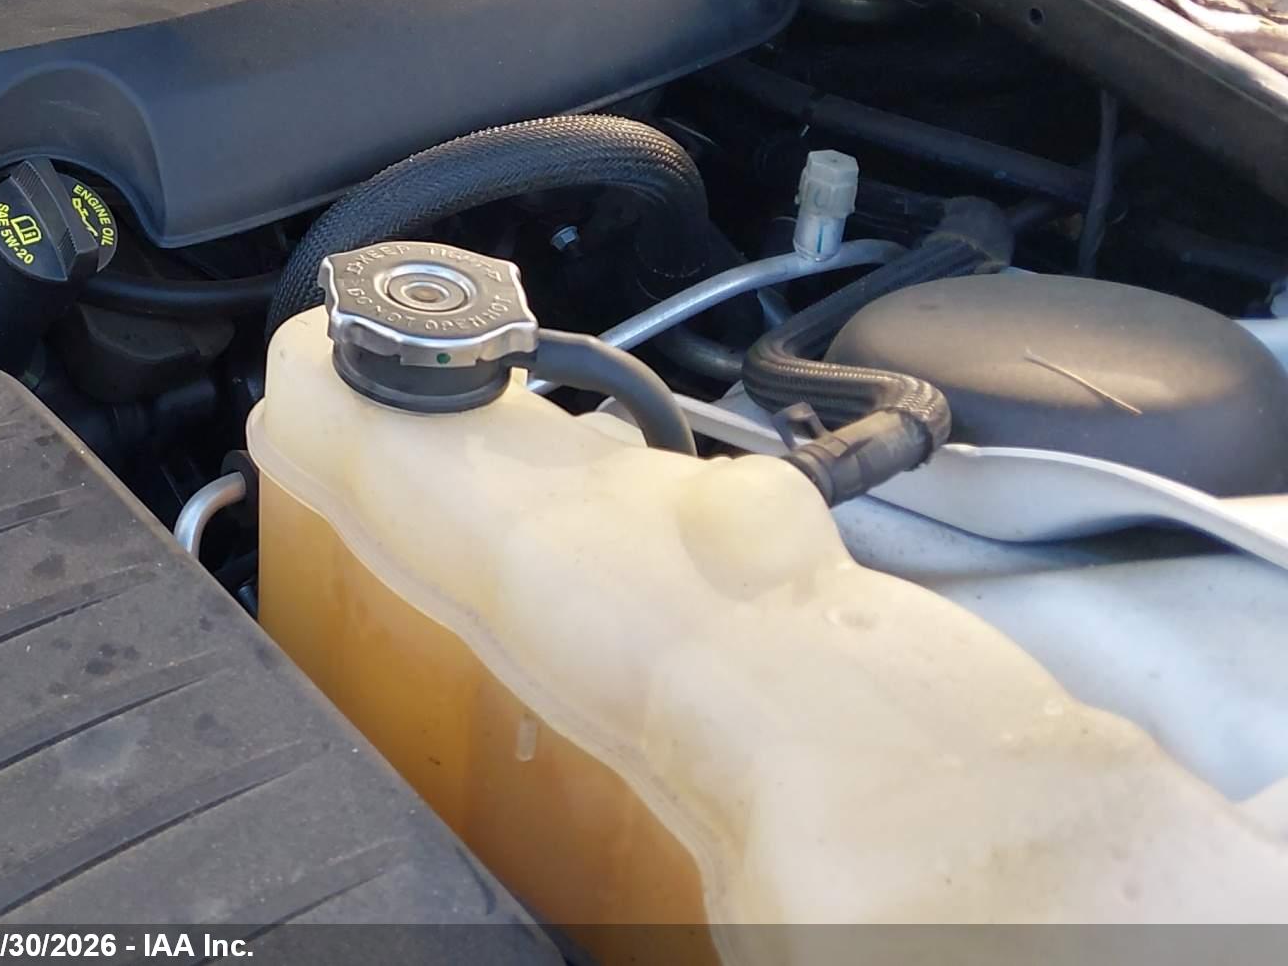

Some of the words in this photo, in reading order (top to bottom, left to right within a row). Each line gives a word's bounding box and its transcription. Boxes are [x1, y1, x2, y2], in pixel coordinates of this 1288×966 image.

[72, 184, 112, 225] ENGINE
[100, 225, 115, 247] OIL
[0, 228, 35, 265] 5W-20
